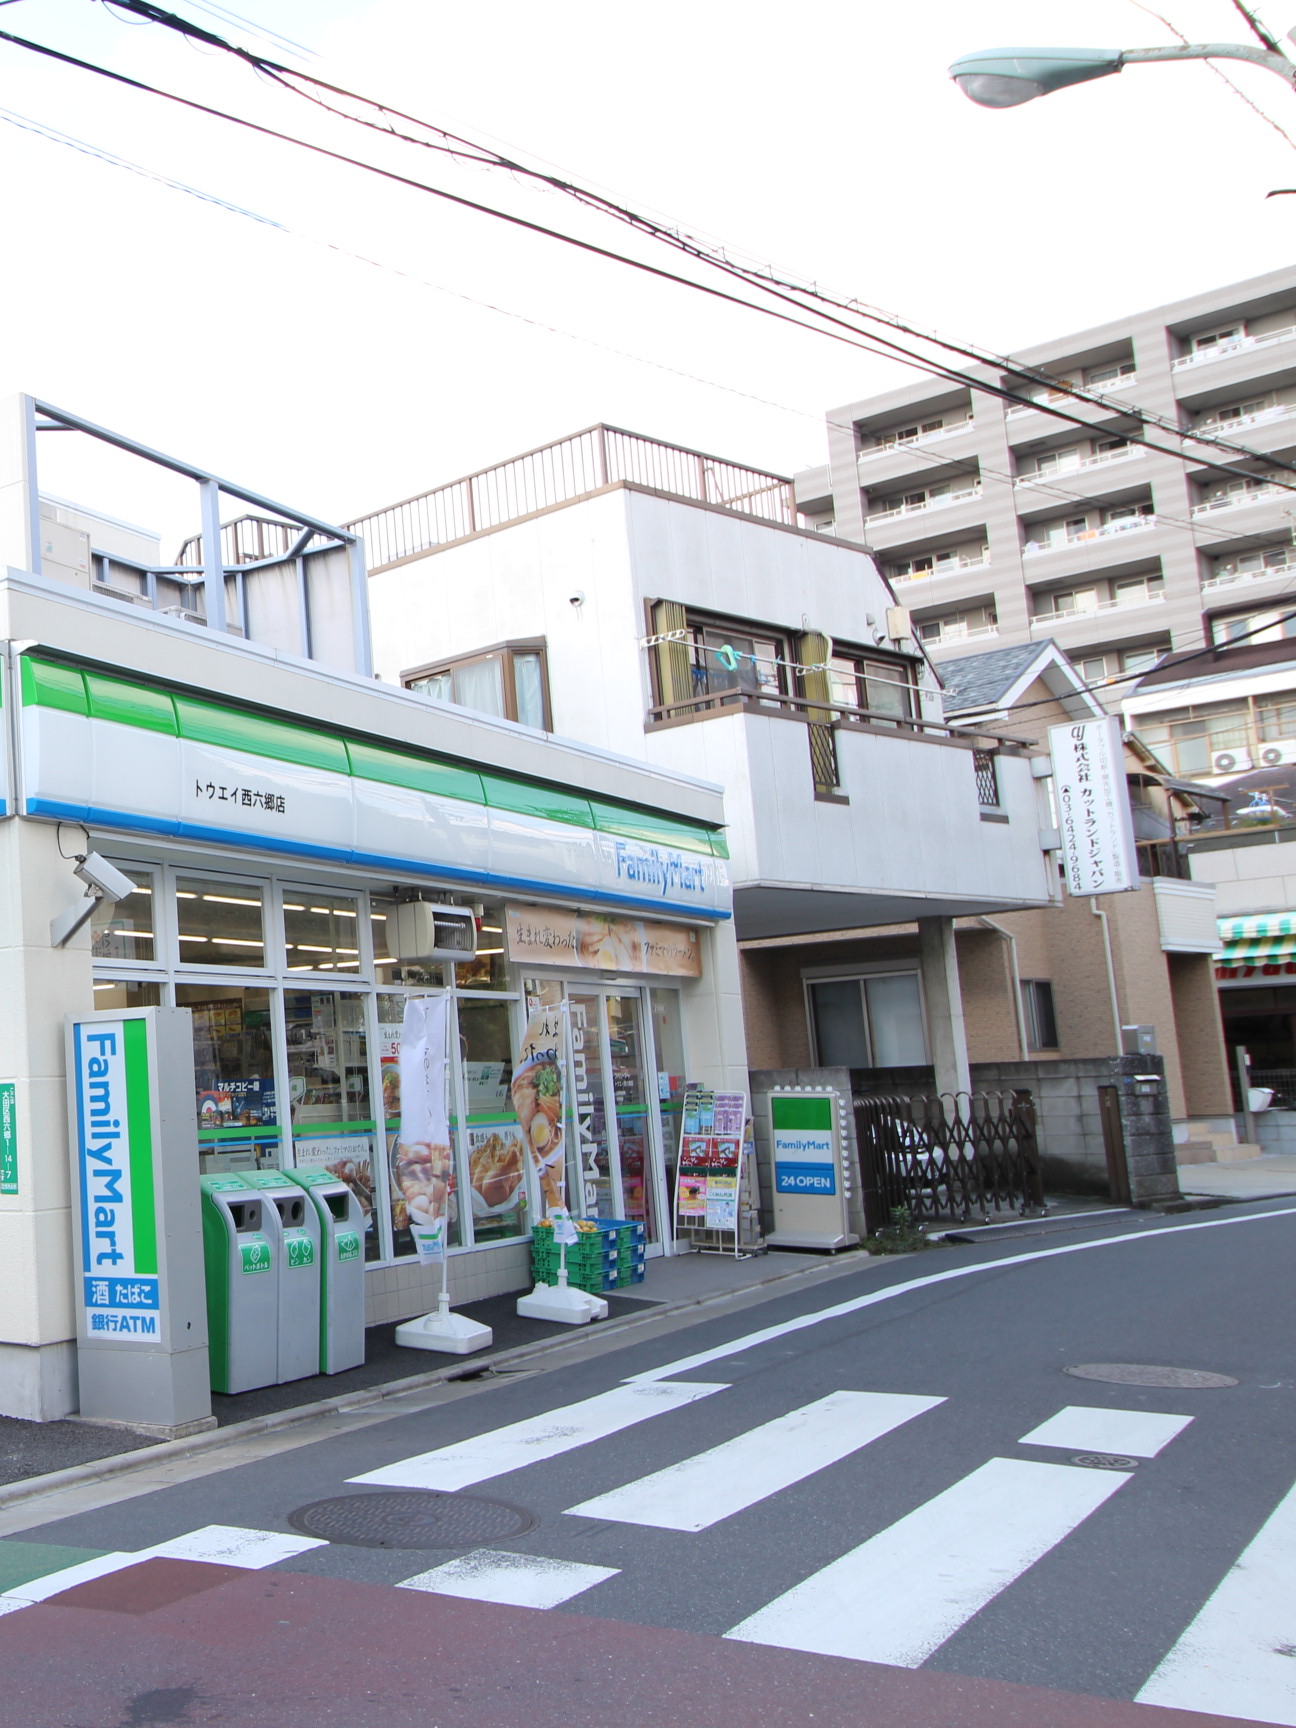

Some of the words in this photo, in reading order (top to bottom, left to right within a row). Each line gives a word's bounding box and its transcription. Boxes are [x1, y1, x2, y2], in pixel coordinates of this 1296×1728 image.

[1074, 743, 1092, 783] 株式会社
[195, 779, 286, 814] トウエイ西六郷店
[1062, 795, 1083, 891] 03-6424-9684
[1080, 787, 1105, 890] カットランドジャパン
[615, 841, 705, 896] FamilyMart
[570, 1003, 600, 1219] FamilyMar
[86, 1032, 125, 1267] FamilyMart
[776, 1140, 831, 1151] FamilyMart
[244, 1262, 269, 1271] ペットボトル
[290, 1258, 300, 1266] ビン
[303, 1256, 312, 1264] カン
[91, 1280, 109, 1305] 酒
[115, 1282, 153, 1305] たばこ
[91, 1313, 156, 1335] 銀行ATM
